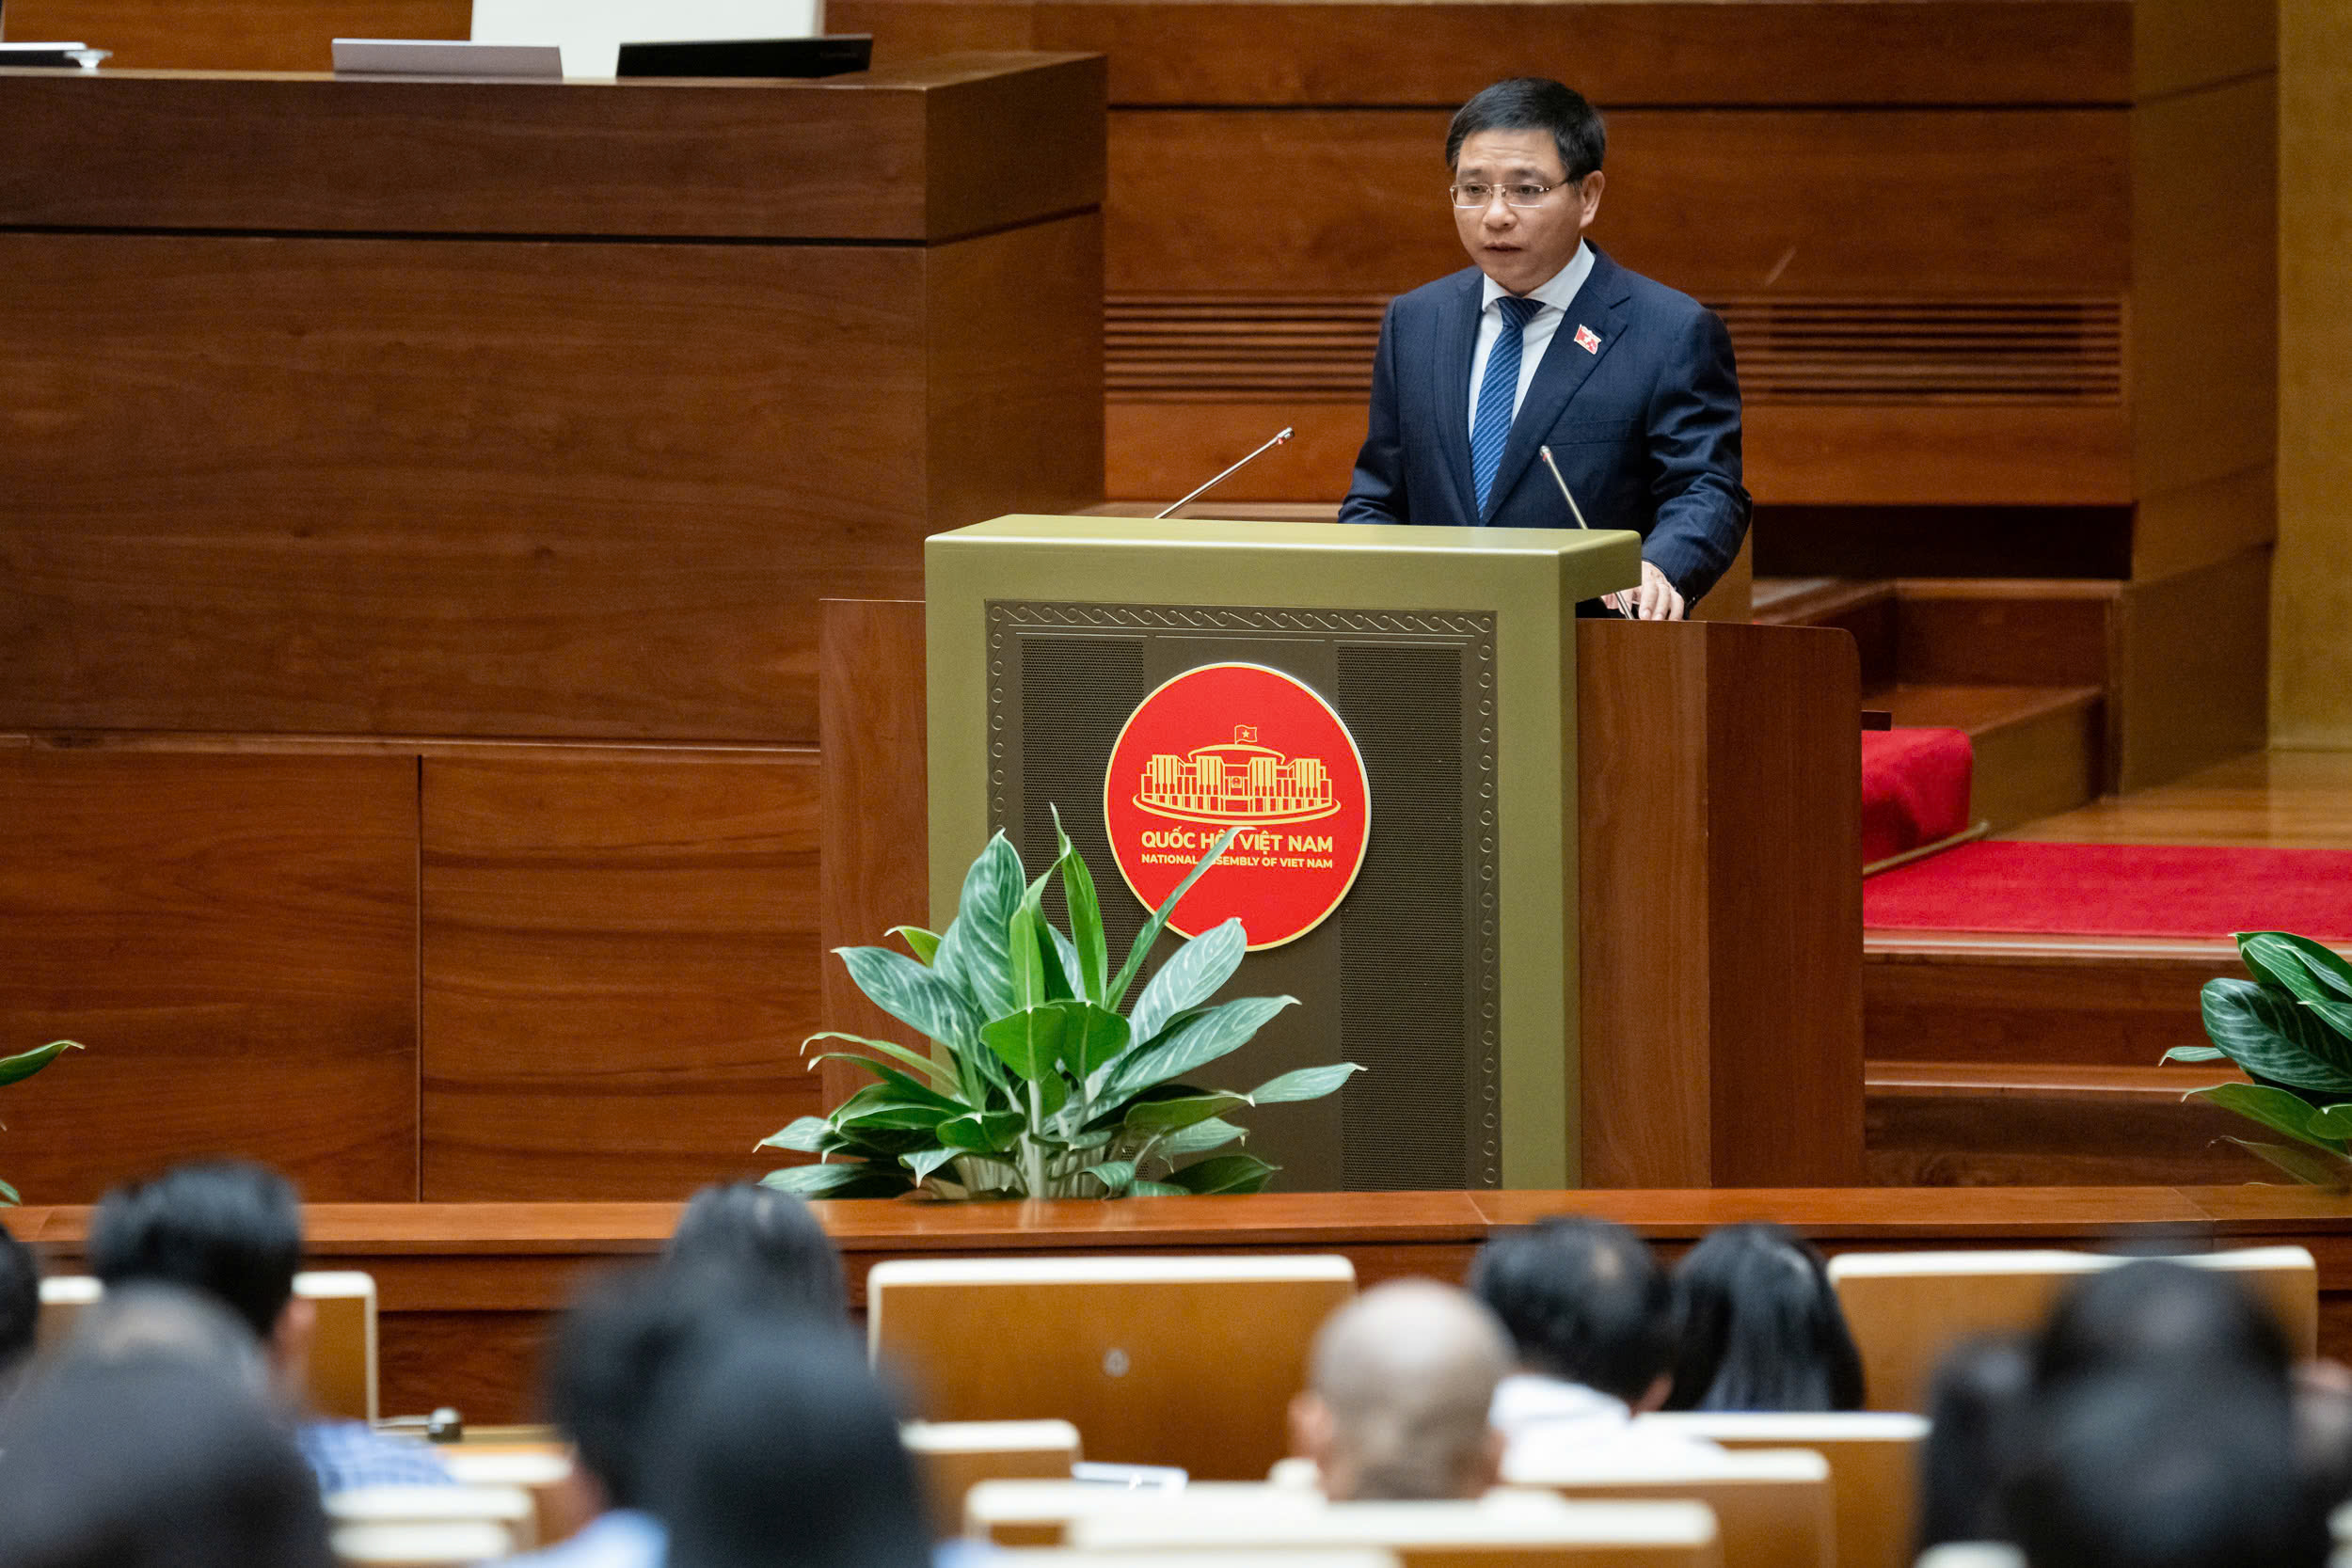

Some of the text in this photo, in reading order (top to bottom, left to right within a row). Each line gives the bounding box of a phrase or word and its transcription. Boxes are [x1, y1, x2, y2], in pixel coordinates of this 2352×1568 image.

[1141, 826, 1196, 848] QUỐC
[1238, 830, 1283, 855] VIỆT
[1288, 834, 1333, 853] NAM
[1141, 853, 1333, 869] NATIONAL SEMBLY OF VIET NAM
